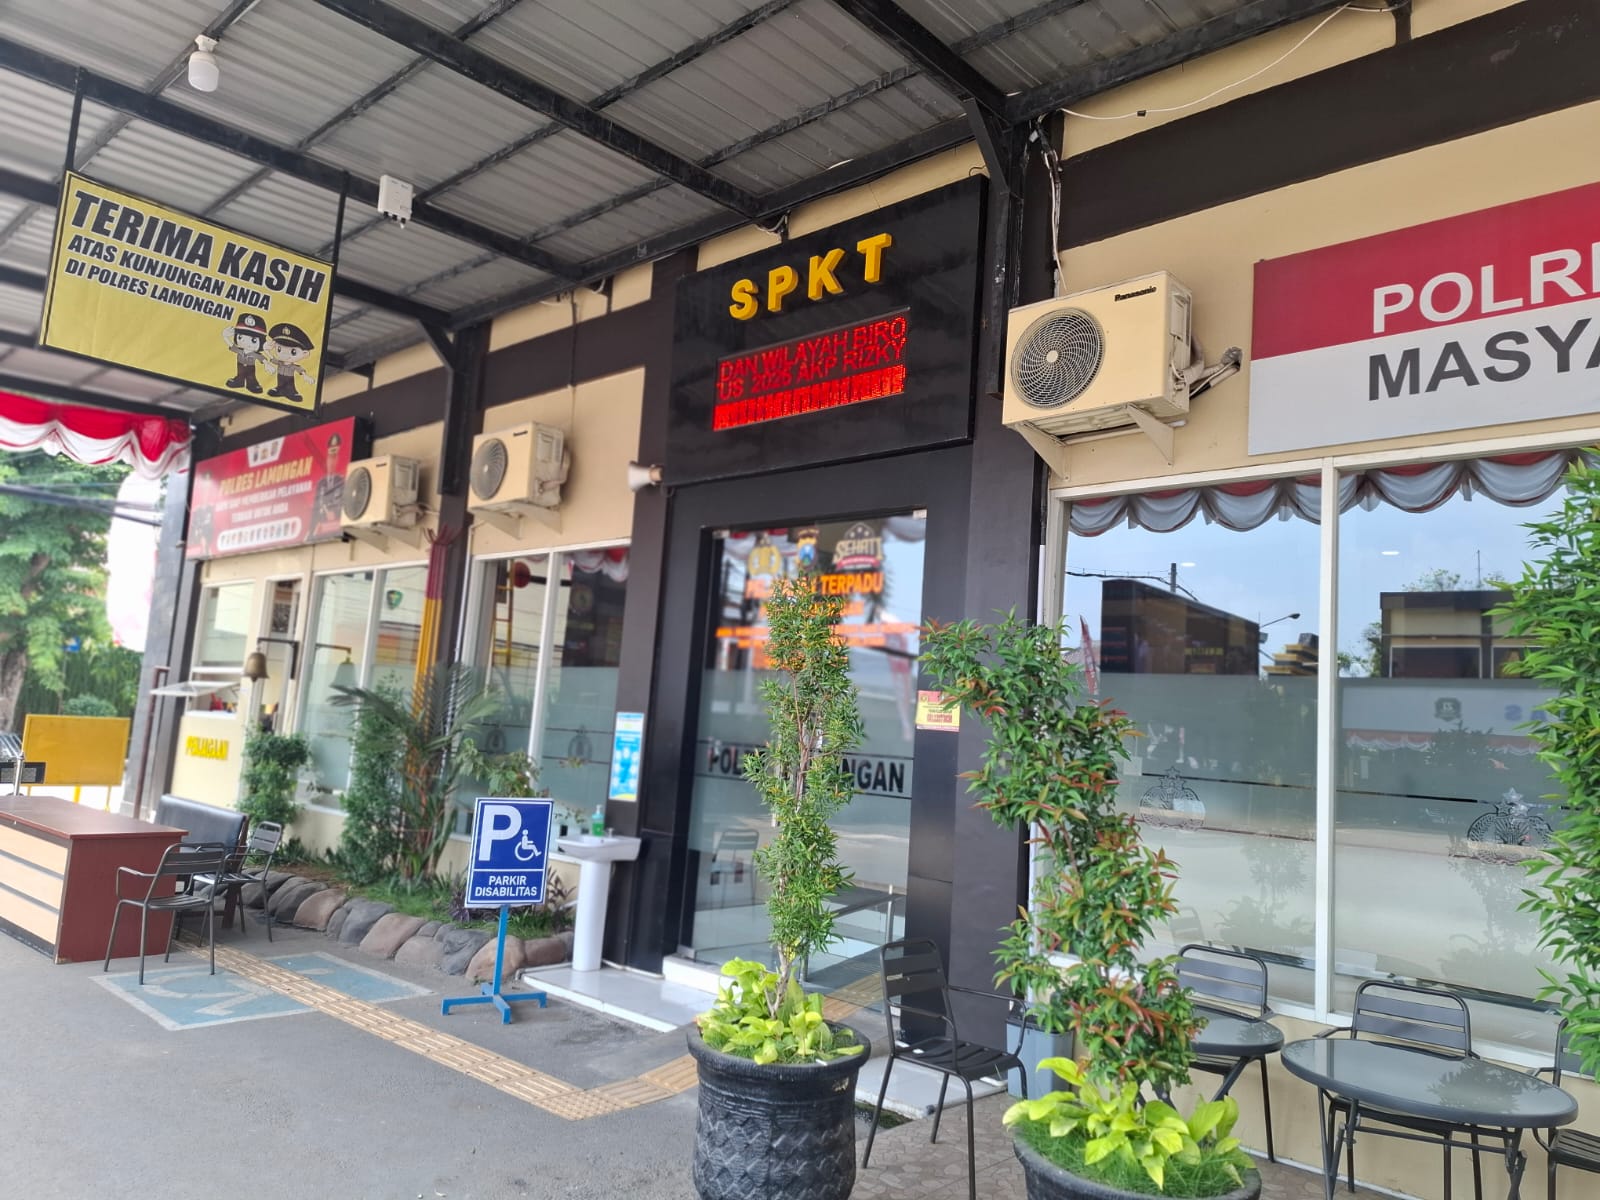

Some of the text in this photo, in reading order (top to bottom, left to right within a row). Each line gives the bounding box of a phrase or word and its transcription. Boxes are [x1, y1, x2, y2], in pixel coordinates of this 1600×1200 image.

[68, 234, 271, 311] ATAS KUNJUNGAN ANDA
[71, 190, 326, 303] TERIMA KASIH
[65, 258, 235, 320] DI POLRES LAMONGAN
[729, 232, 893, 321] SPKT
[761, 331, 848, 376] WILAYAH
[852, 316, 907, 350] BIRO
[796, 356, 837, 382] AKP
[842, 336, 906, 373] RIZKY
[820, 572, 885, 596] TERPADU
[479, 804, 522, 861] P
[475, 886, 537, 897] DISABILITAS
[488, 875, 527, 886] PARKIR
